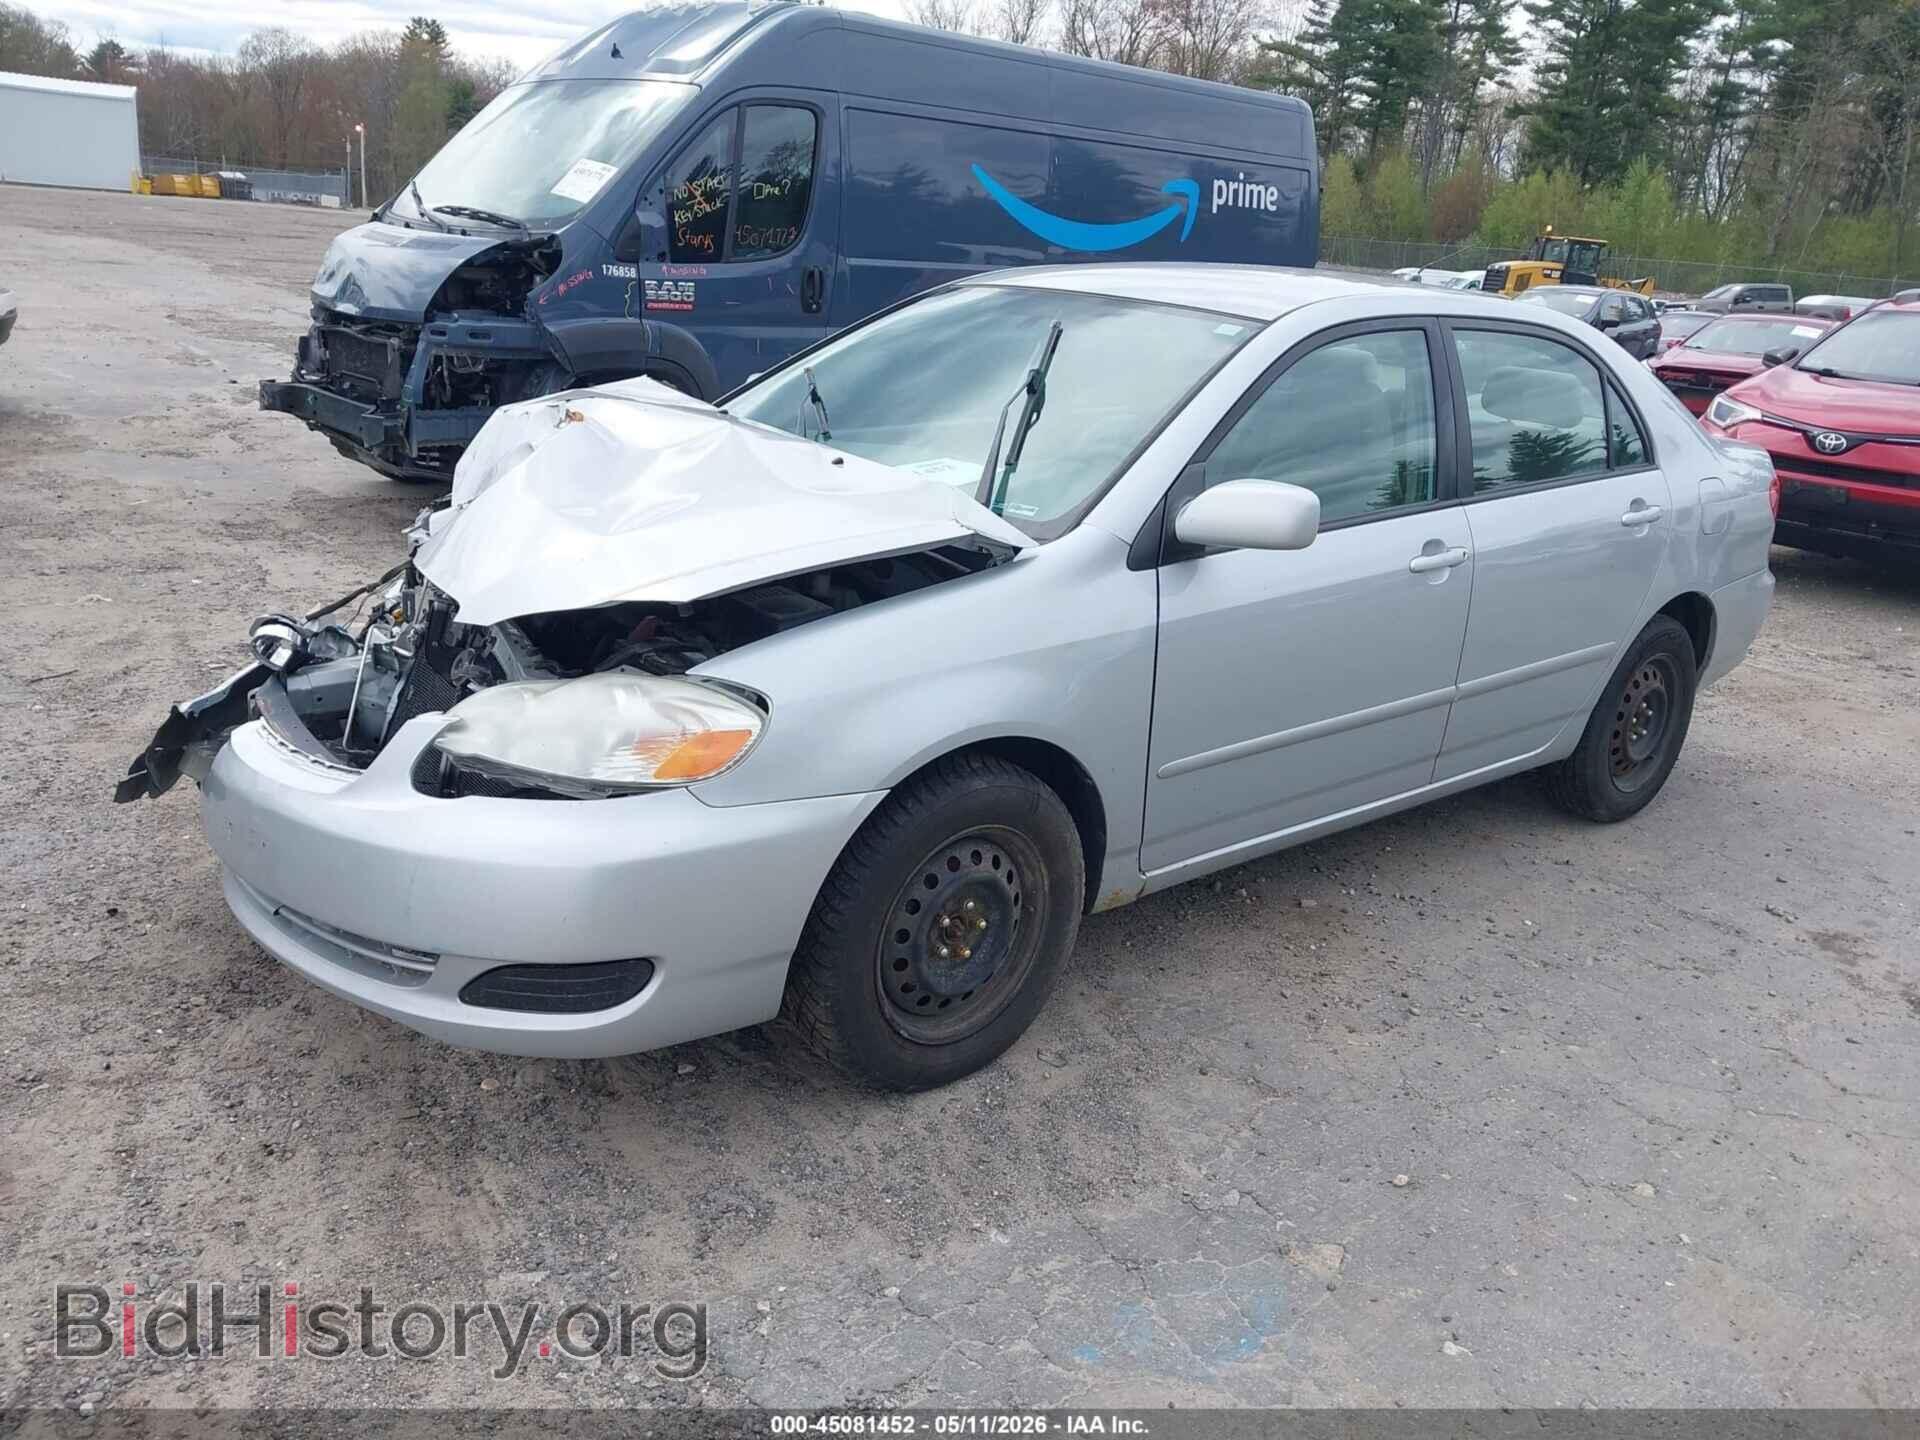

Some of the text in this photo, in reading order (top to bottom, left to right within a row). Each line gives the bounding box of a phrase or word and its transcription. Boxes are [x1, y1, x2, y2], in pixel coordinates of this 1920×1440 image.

[674, 174, 726, 200] NO START
[1212, 172, 1278, 214] prime
[602, 264, 636, 278] 176858
[645, 280, 696, 291] RAM
